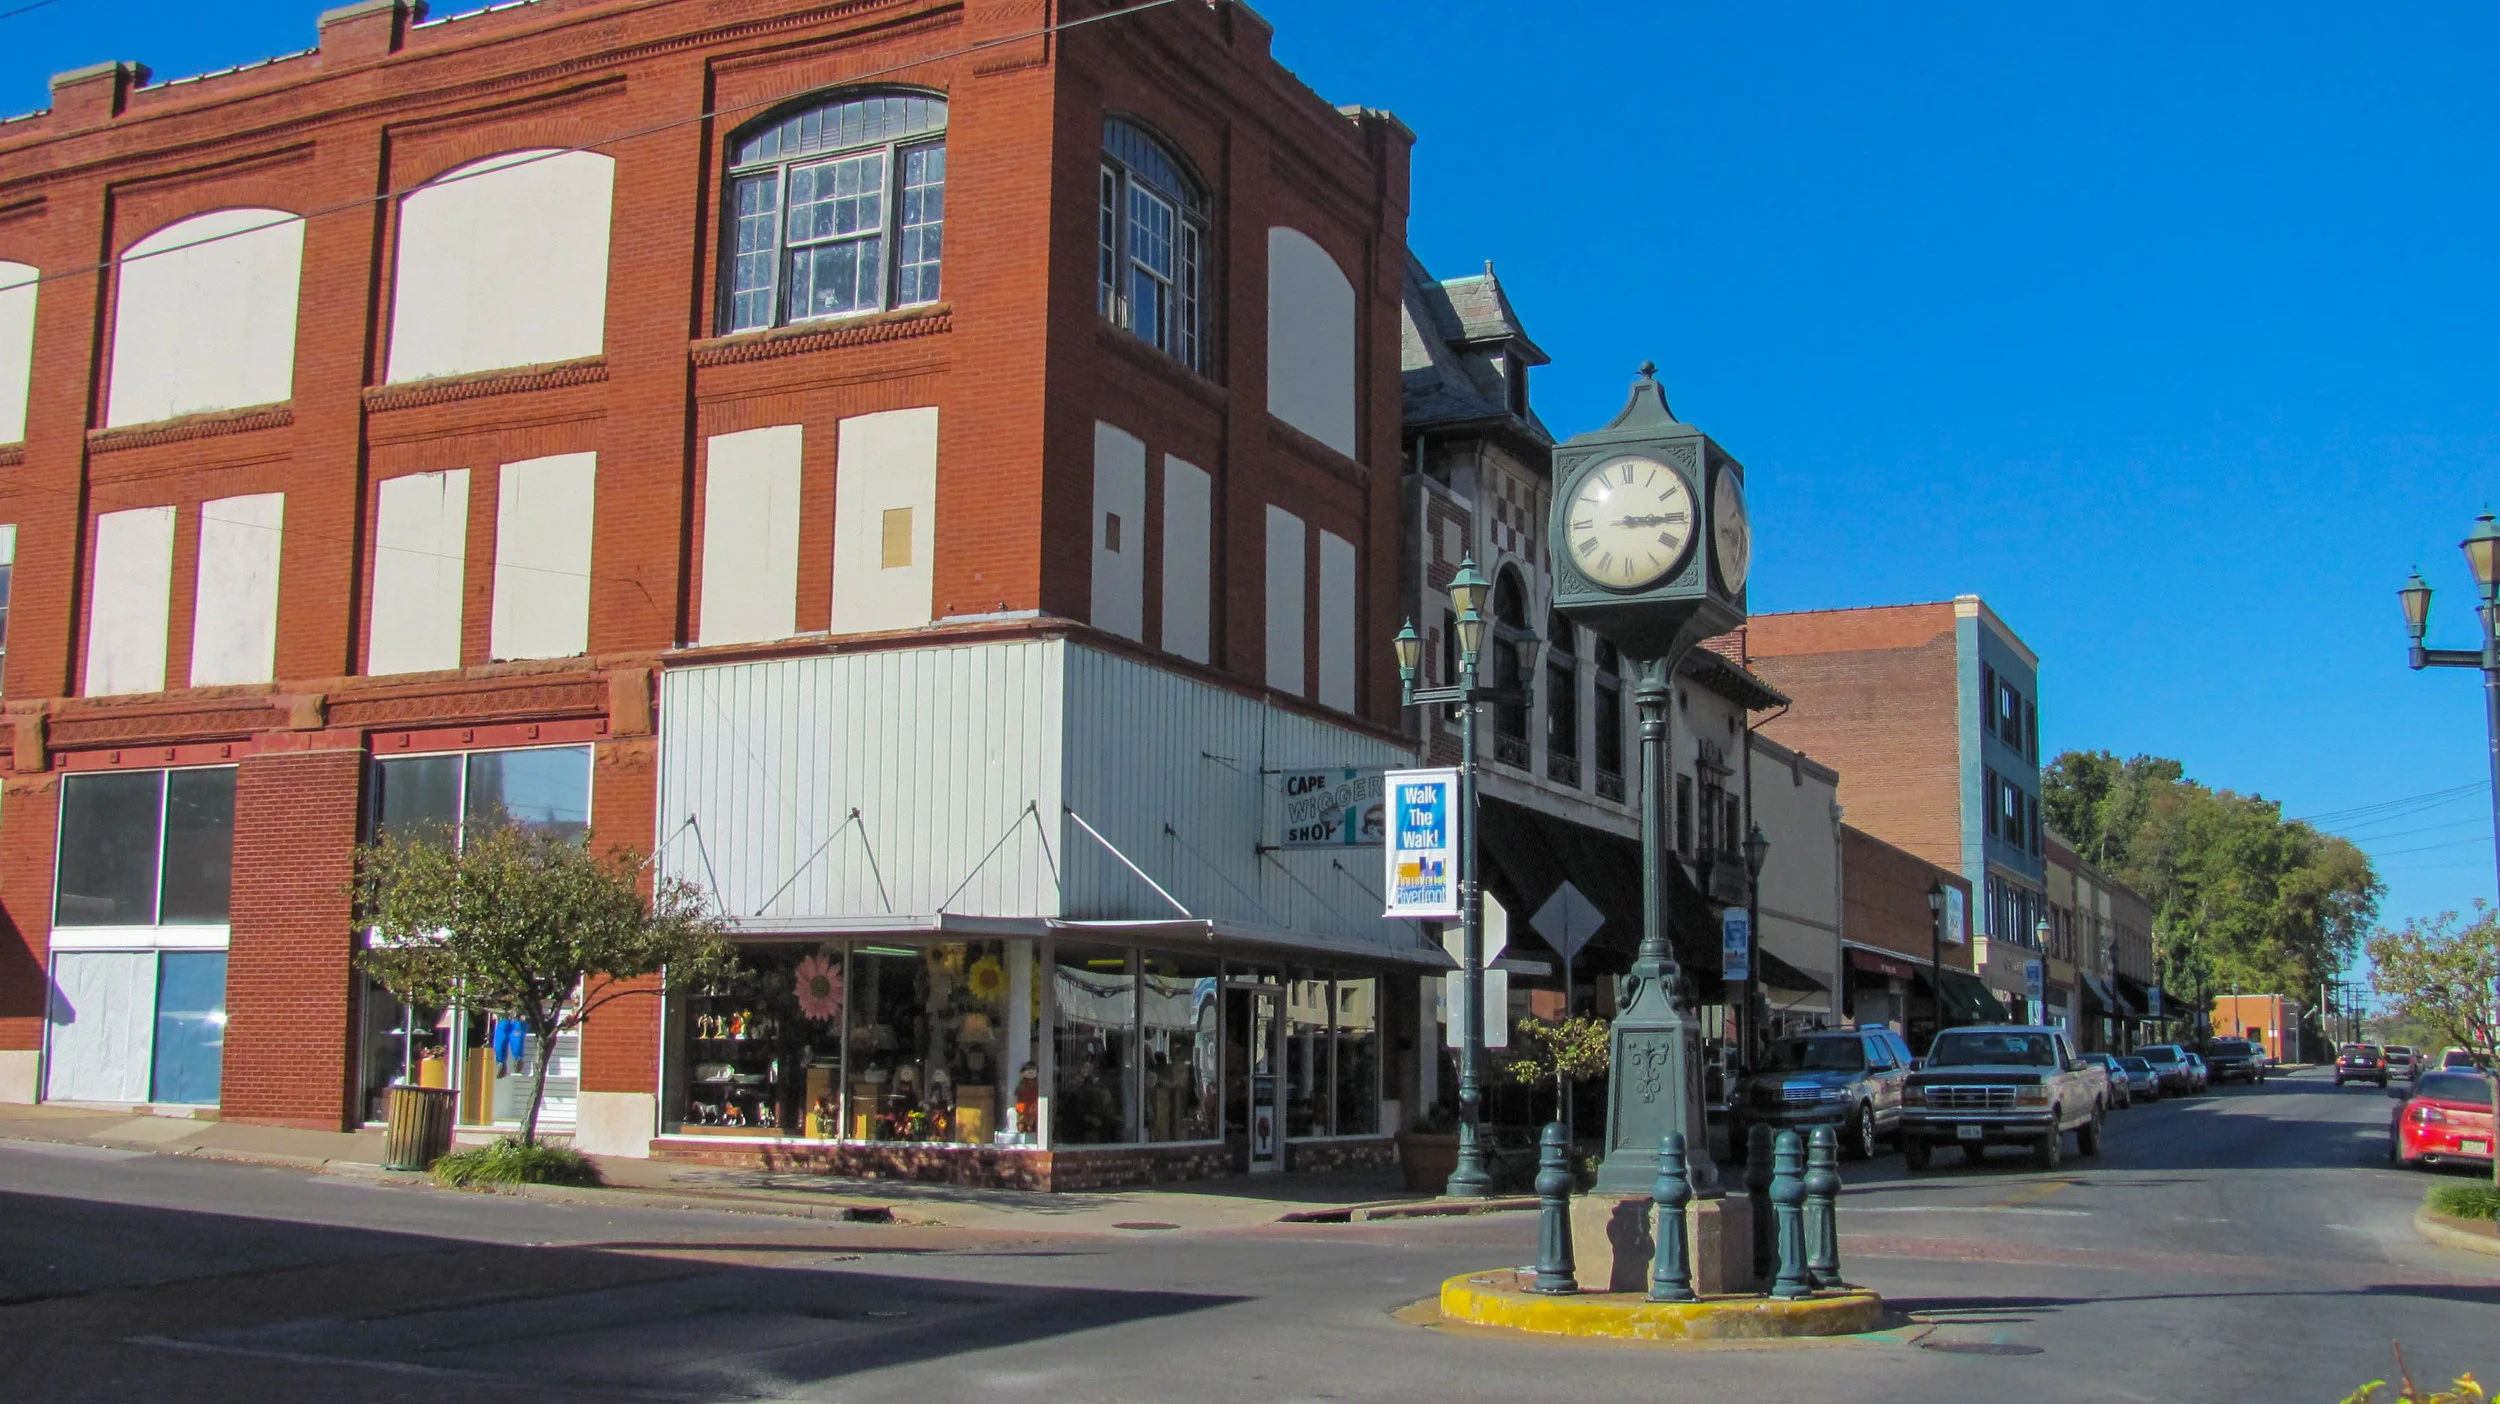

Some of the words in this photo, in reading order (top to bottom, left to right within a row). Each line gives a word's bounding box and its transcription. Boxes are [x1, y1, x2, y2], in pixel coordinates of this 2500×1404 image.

[1645, 470, 1656, 488] I
[1659, 486, 1677, 501] II
[1287, 776, 1325, 796] CAPE
[1405, 786, 1437, 804] Walk
[1409, 808, 1433, 826] The
[1403, 829, 1439, 848] Walk!
[1396, 886, 1447, 904] Riverfront
